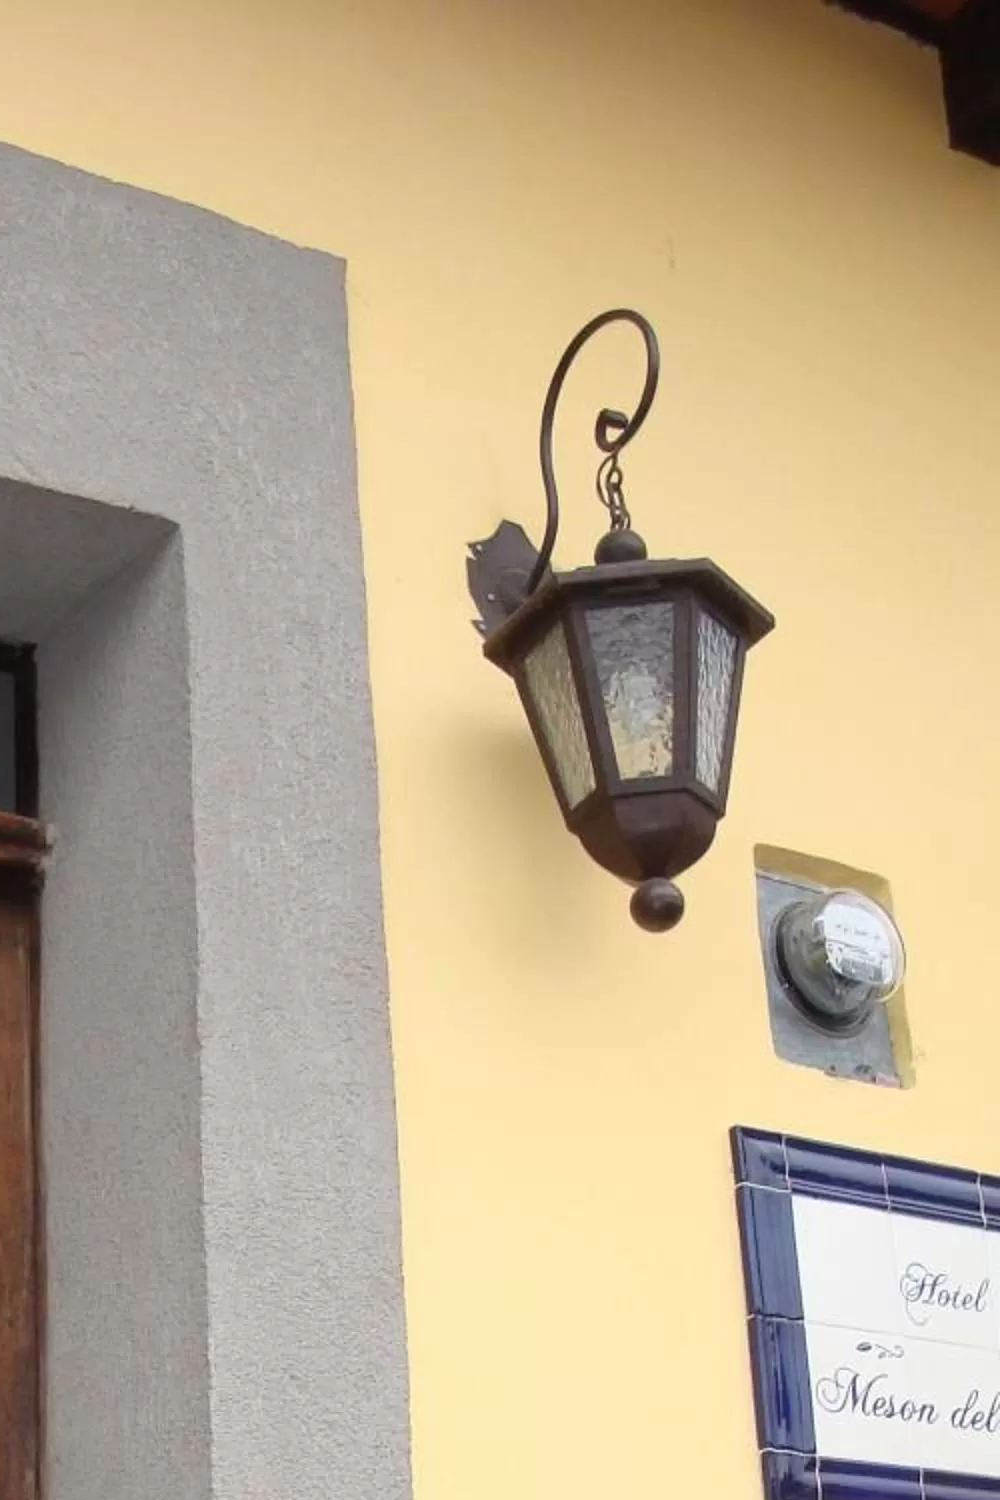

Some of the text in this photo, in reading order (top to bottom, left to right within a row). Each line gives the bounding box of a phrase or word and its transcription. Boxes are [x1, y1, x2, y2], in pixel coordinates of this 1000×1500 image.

[900, 1262, 990, 1326] Hotel
[816, 1367, 1000, 1433] Meson del
